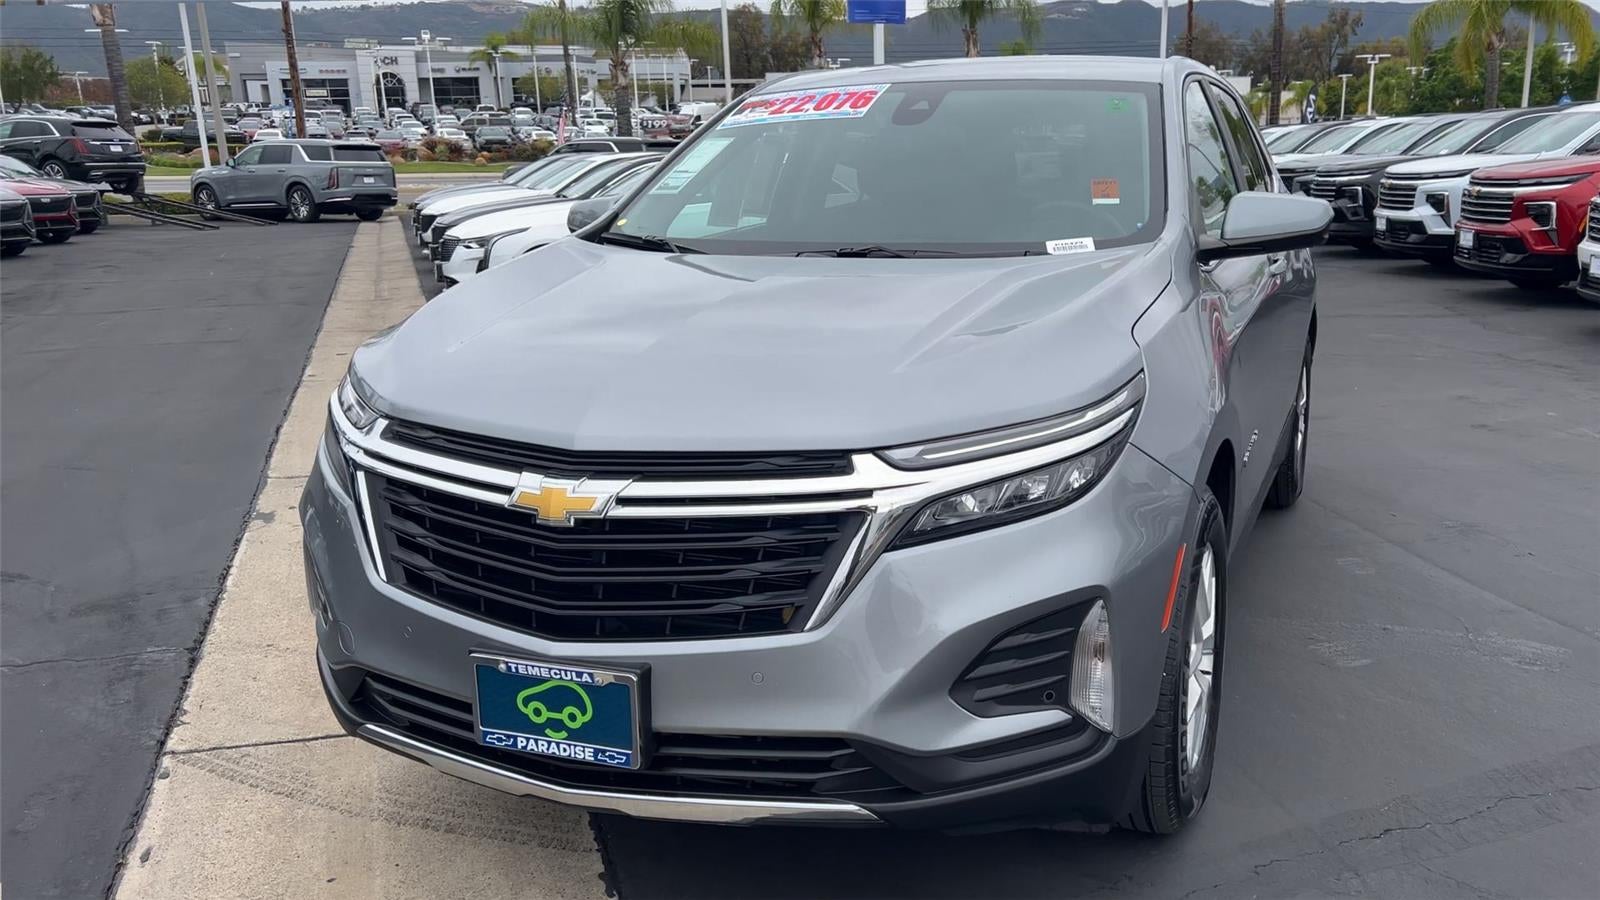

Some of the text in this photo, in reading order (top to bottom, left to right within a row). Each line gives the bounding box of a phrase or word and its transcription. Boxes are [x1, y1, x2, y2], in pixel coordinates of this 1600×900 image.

[767, 90, 878, 116] $22,076
[642, 119, 668, 128] $199
[508, 663, 593, 683] TEMECULA
[517, 737, 595, 761] PARADISE
